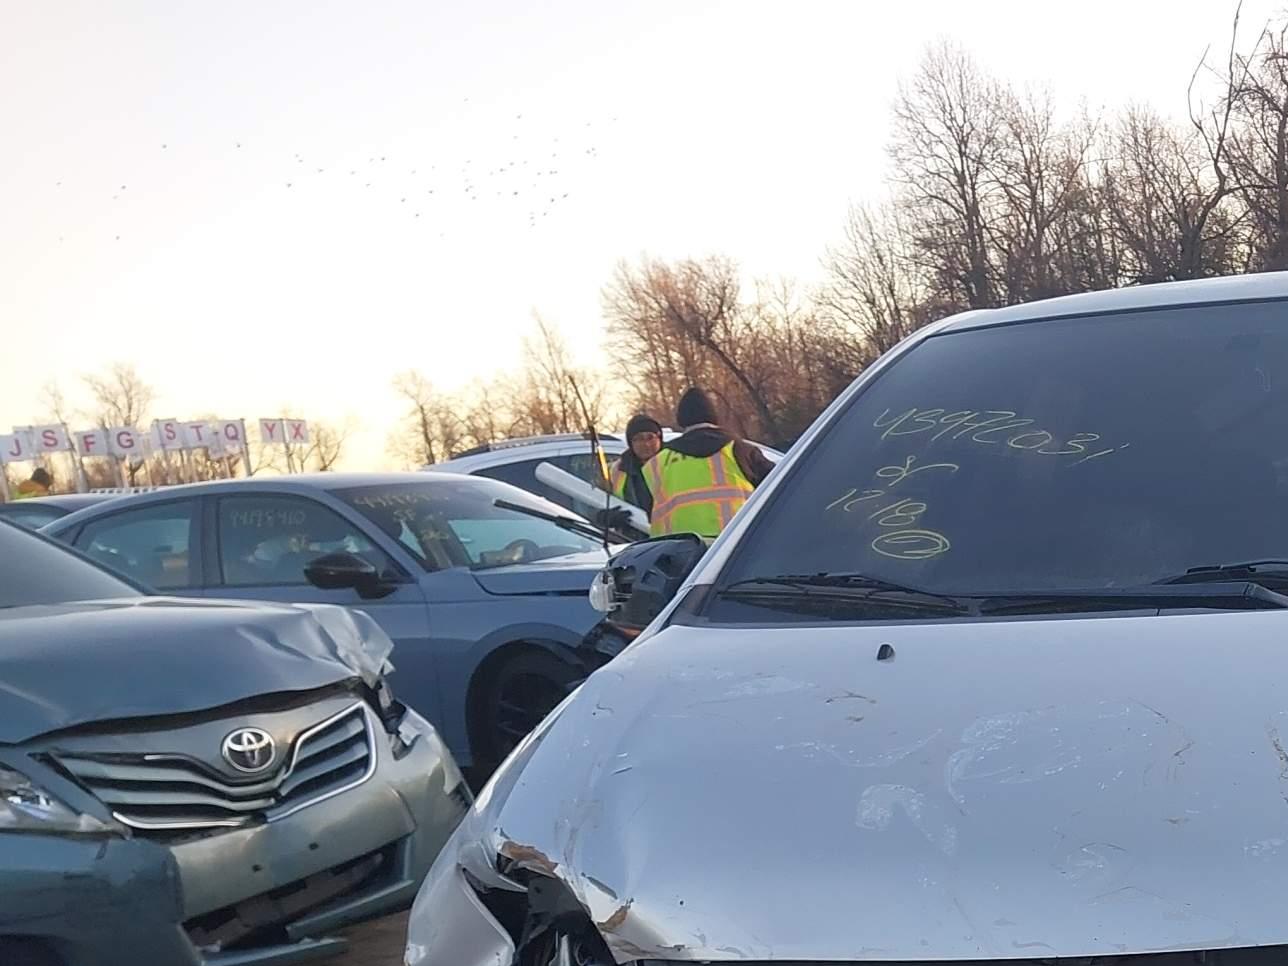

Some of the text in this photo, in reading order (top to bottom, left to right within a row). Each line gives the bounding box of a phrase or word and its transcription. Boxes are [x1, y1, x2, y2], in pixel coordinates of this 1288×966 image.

[41, 430, 58, 447] S
[116, 431, 134, 448] G
[164, 423, 177, 441] S
[190, 425, 203, 441] T
[224, 423, 239, 440] Q
[264, 423, 276, 439] Y
[291, 423, 304, 439] X
[9, 439, 21, 456] J
[83, 434, 96, 452] F
